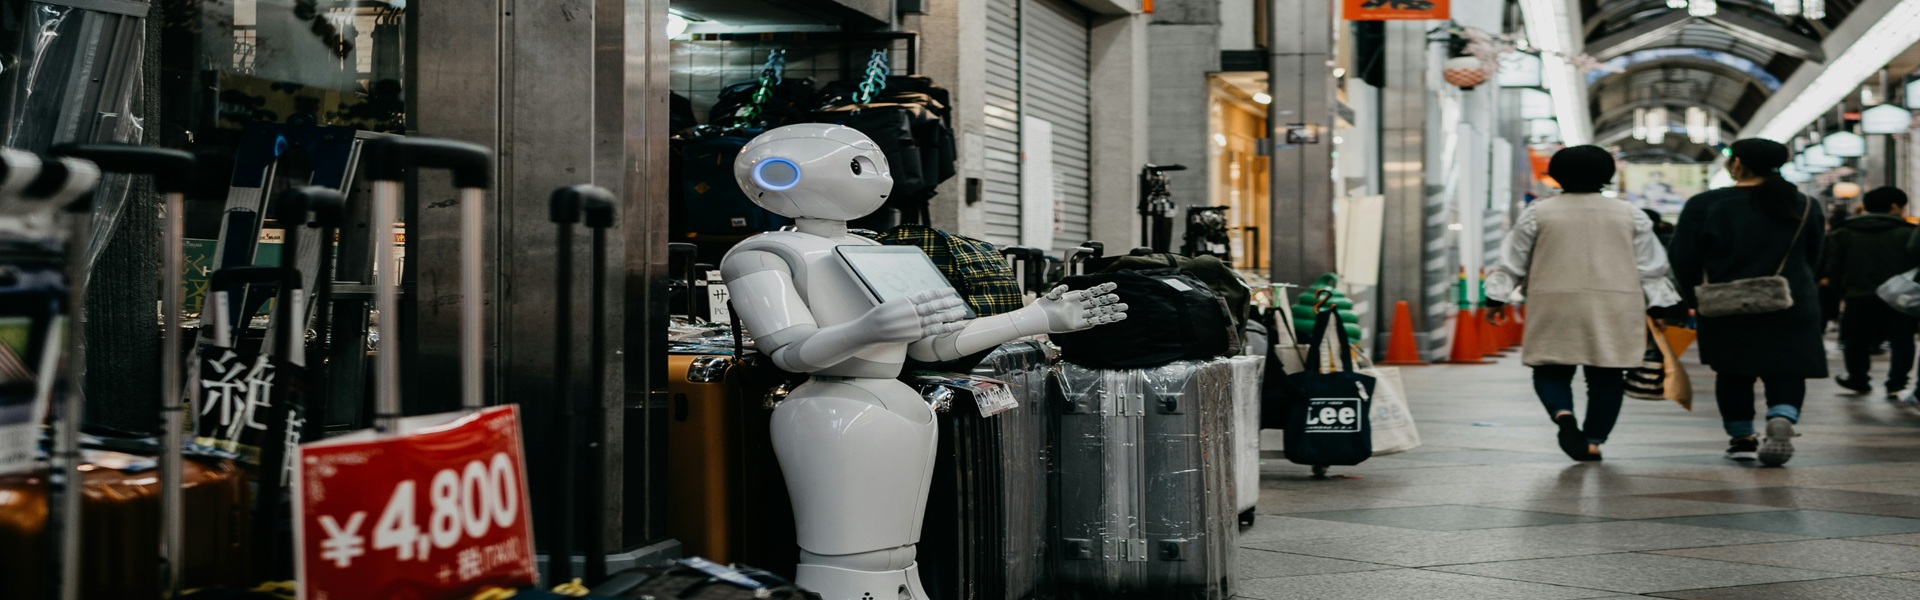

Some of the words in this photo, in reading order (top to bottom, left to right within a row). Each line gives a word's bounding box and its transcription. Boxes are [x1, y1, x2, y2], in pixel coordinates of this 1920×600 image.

[1306, 406, 1356, 425] Lee
[1371, 404, 1401, 422] ee
[317, 452, 518, 568] ¥4,800
